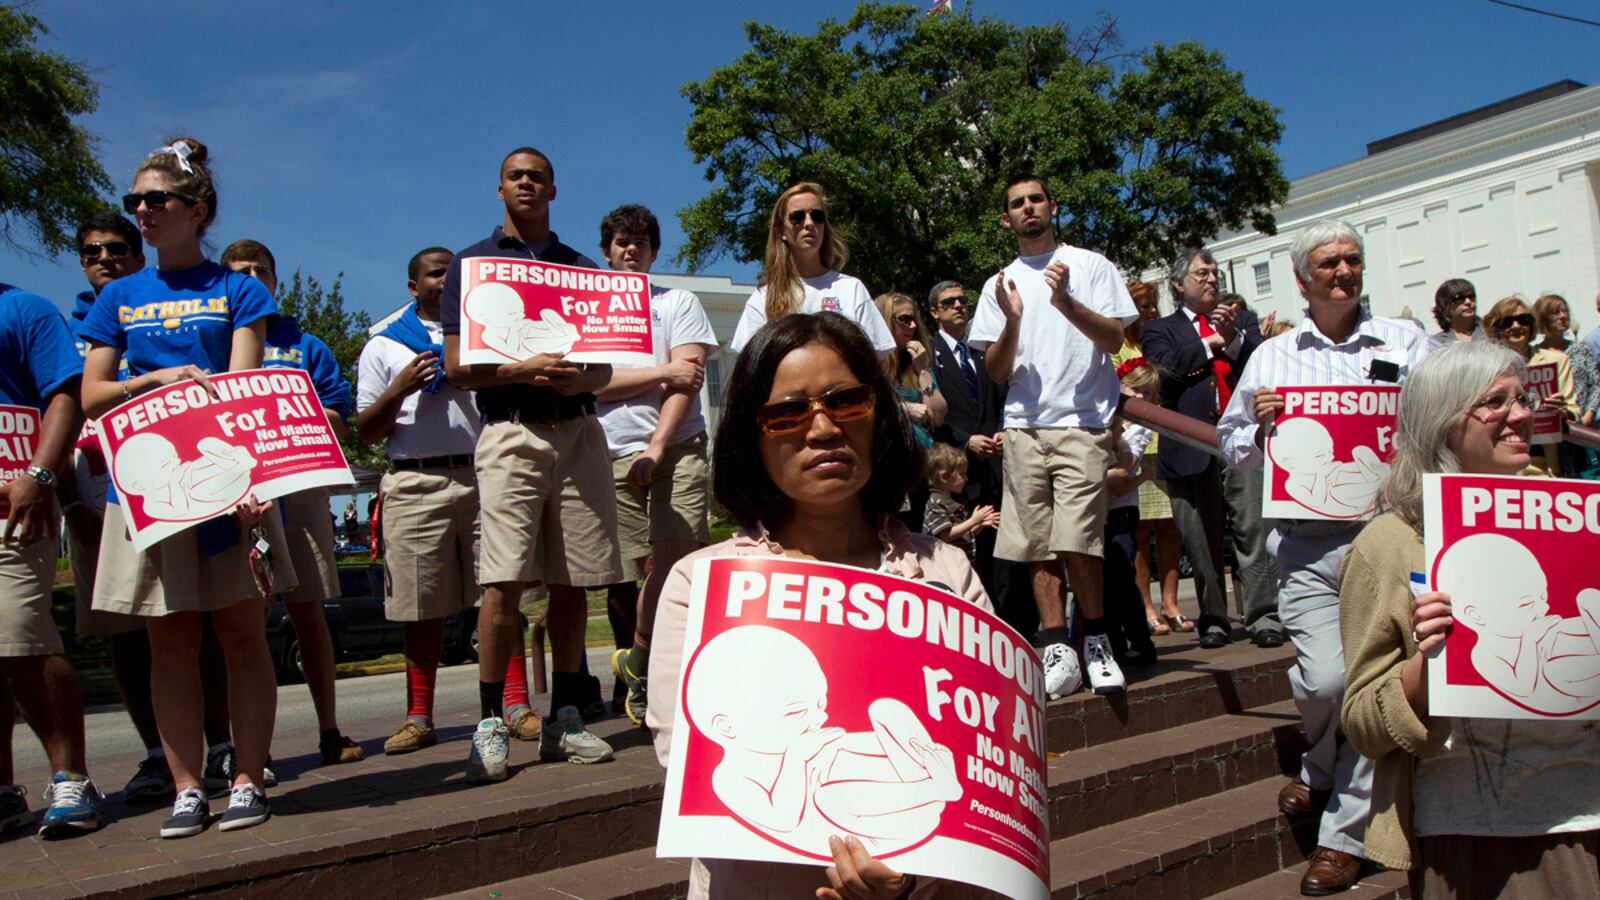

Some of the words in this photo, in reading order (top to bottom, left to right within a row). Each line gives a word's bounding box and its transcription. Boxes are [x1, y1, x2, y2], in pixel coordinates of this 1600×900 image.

[479, 262, 644, 293] PERSONHOOD
[118, 295, 229, 324] CATHOLIC
[608, 292, 642, 313] All
[582, 323, 610, 333] How
[613, 323, 648, 334] Small
[586, 315, 603, 325] No
[606, 315, 647, 325] Matter
[110, 374, 309, 440] PERSONHOOD
[276, 395, 317, 421] All
[1284, 391, 1401, 415] PERSON
[253, 439, 289, 454] How
[291, 434, 333, 446] Small
[255, 428, 278, 442] No
[279, 423, 327, 437] Matter
[976, 732, 1005, 767] No
[967, 754, 1014, 798] How
